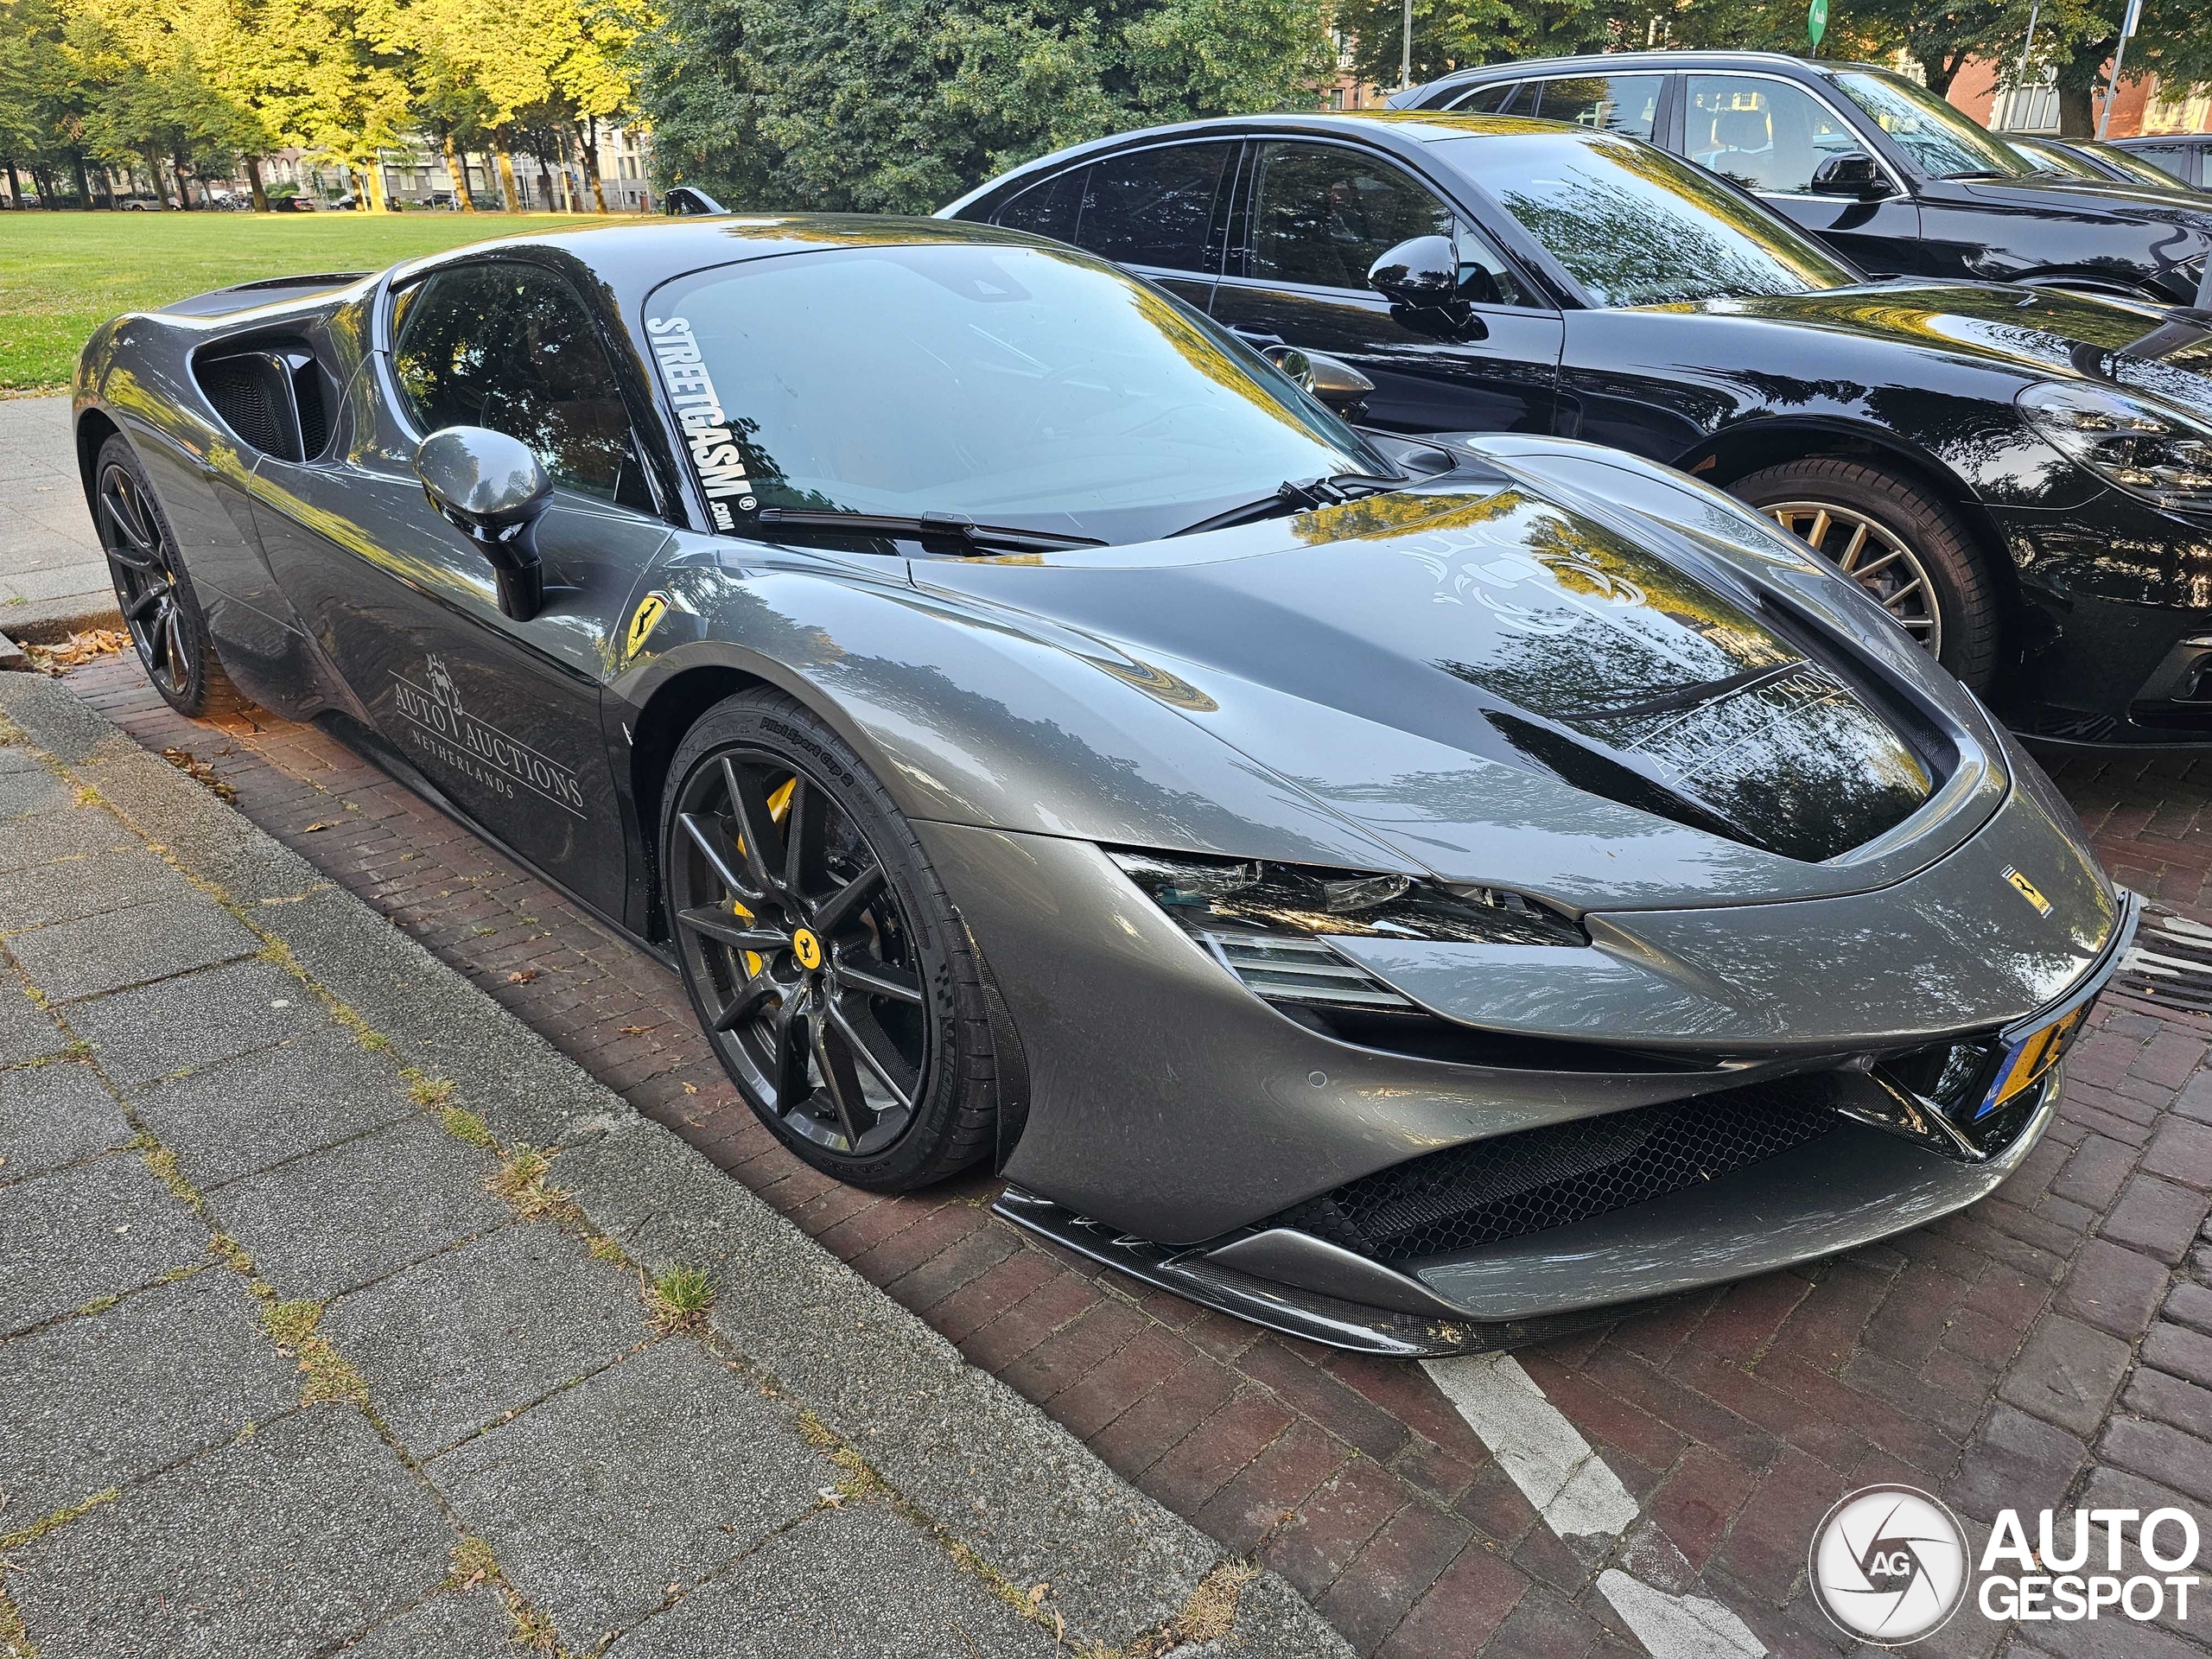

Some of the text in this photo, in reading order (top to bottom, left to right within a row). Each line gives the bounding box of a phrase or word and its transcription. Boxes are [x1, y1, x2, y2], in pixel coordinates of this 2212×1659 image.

[647, 317, 753, 499] STREETGASM
[396, 683, 583, 808] AUTO AUCTIONS
[412, 729, 513, 799] NETHERLANDS
[760, 717, 788, 736] Pilot
[786, 728, 822, 757] Sport
[820, 753, 842, 776] Cup
[840, 773, 855, 787] 2
[1646, 664, 1845, 779] AUTO AUCTIONS
[924, 1042, 956, 1137] MICHELIN
[1981, 1084, 2000, 1104] NL
